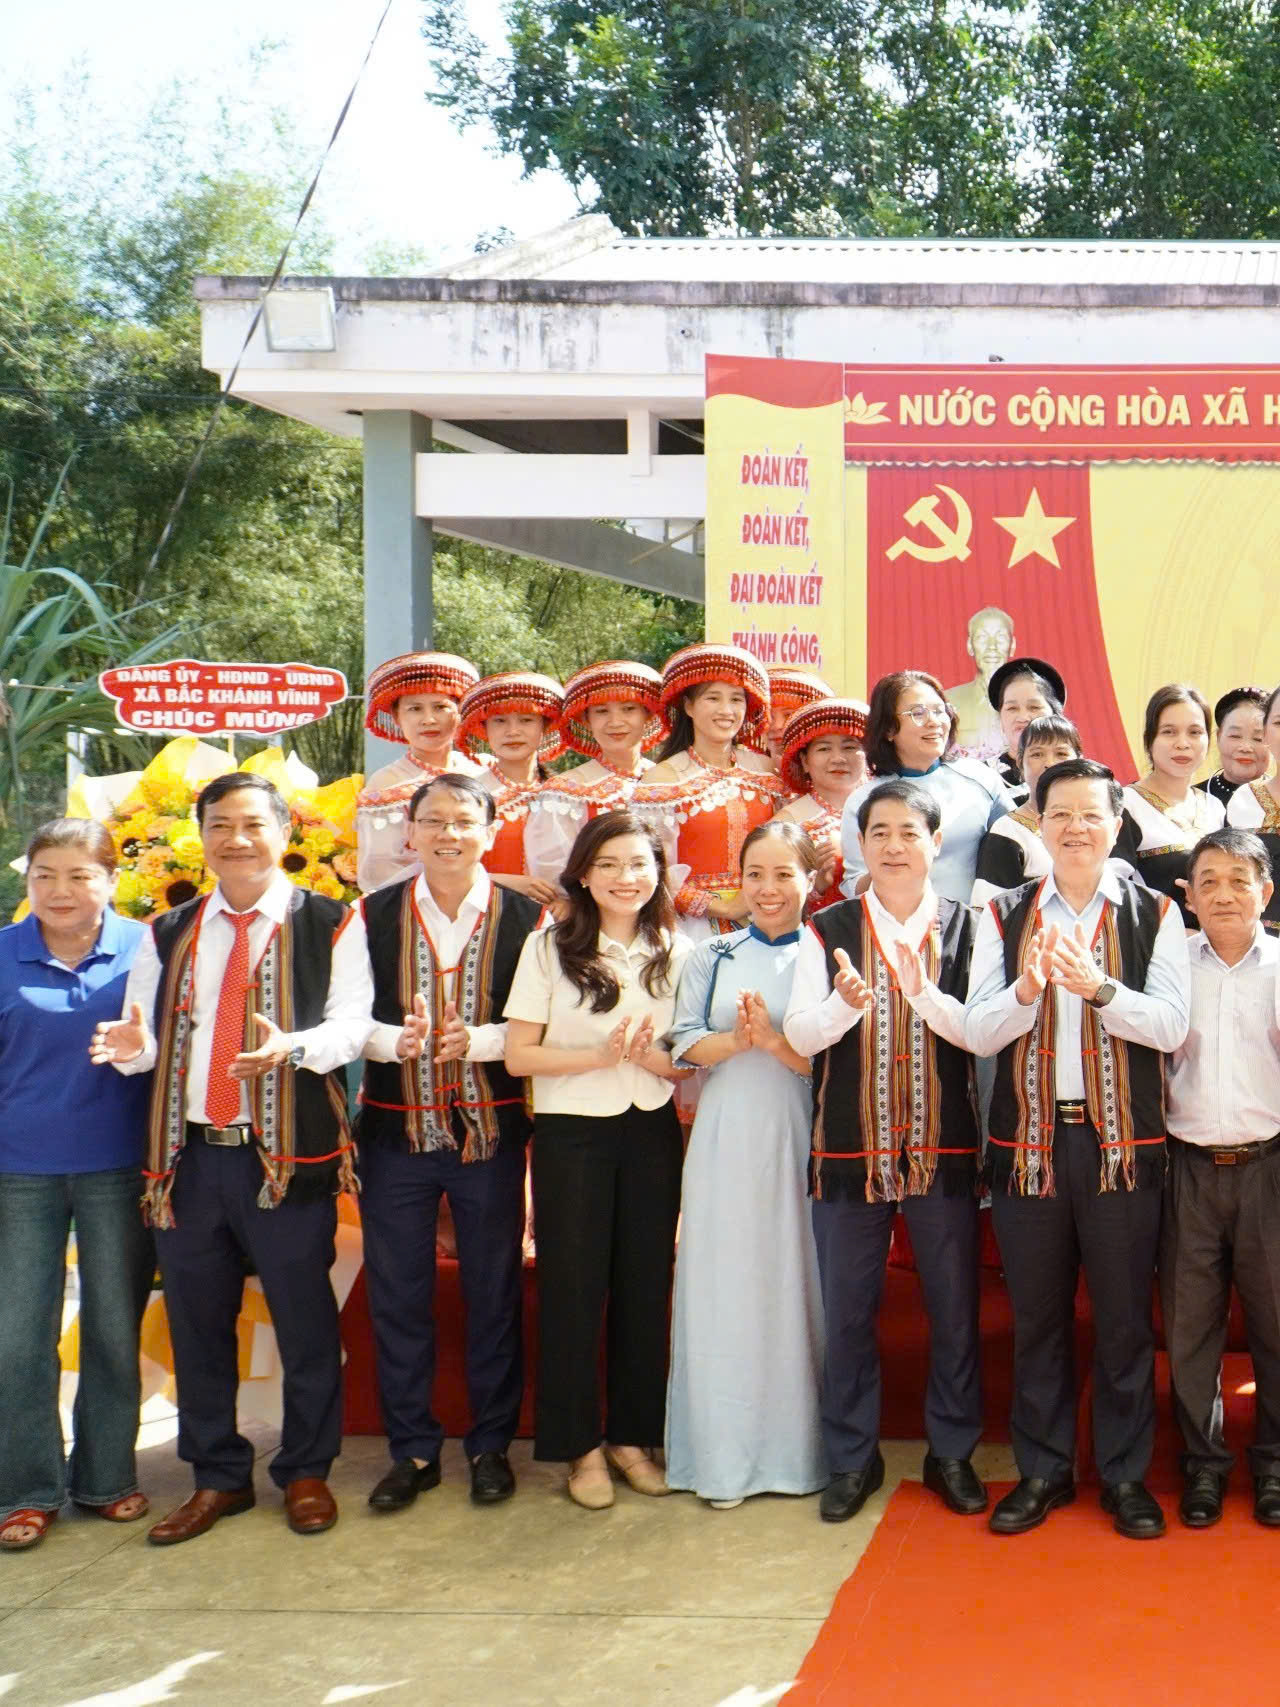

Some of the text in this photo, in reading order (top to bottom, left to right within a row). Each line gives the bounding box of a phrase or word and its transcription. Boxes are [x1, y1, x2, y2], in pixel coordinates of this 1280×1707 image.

[899, 387, 996, 426] NƯỚC
[1007, 386, 1105, 432] CỘNG
[1117, 386, 1192, 426] HÒA
[1202, 386, 1250, 426] XÃ
[741, 443, 809, 494] ĐOÀN KẾT,
[742, 502, 809, 552] ĐOÀN KẾT,
[730, 562, 823, 612] ĐẠI ĐOÀN KẾT
[780, 625, 822, 669] CÔNG,
[134, 684, 320, 706] XÃ BẮC KHÁNH VĨNH
[218, 671, 269, 685] HĐND
[286, 672, 335, 686] UBND
[131, 708, 315, 728] CHÚC MỪNG
